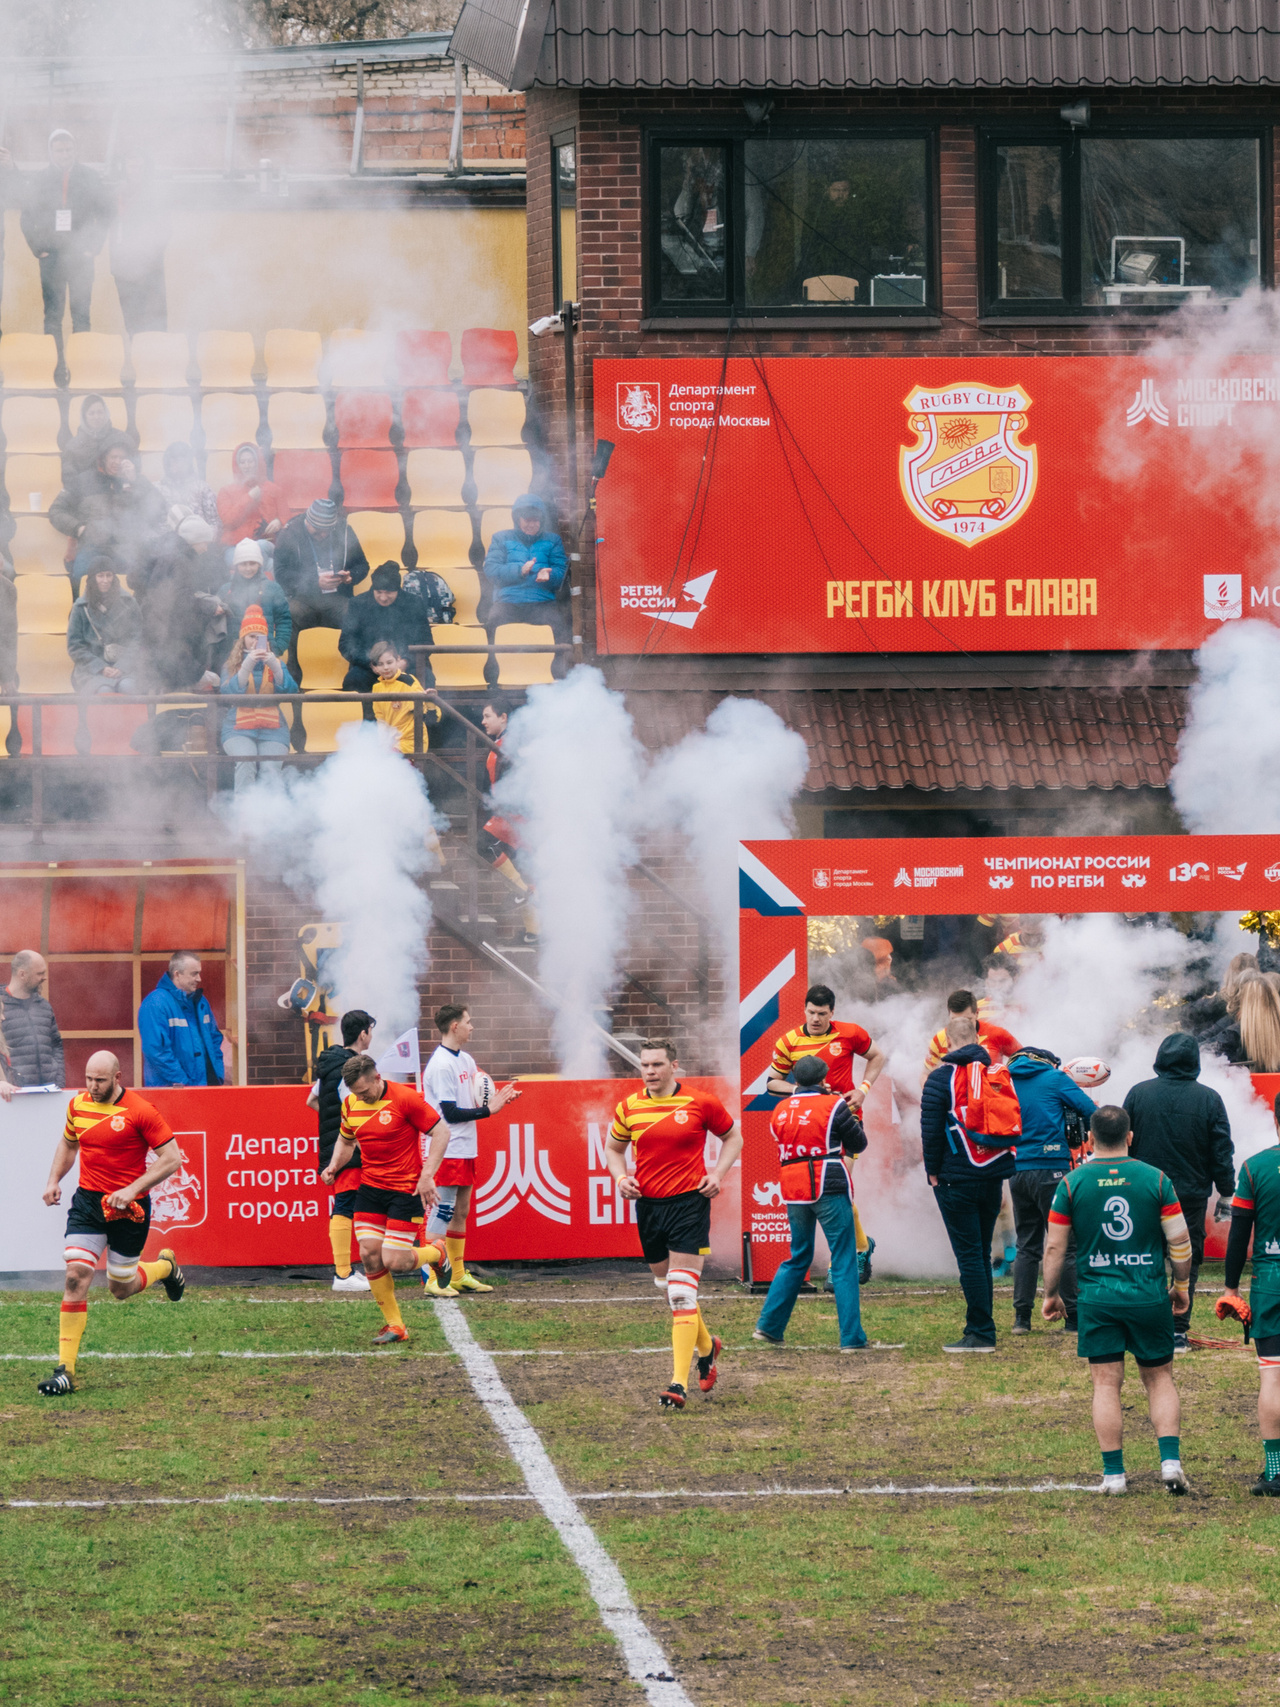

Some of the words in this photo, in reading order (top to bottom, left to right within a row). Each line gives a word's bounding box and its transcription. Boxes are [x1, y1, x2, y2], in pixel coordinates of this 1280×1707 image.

[669, 384, 757, 398] Департамент
[669, 402, 715, 414] спорта
[920, 393, 971, 410] RUGBY
[976, 393, 1017, 409] CLUB
[1177, 403, 1236, 427] СПОРТ
[669, 417, 715, 429] города
[718, 415, 770, 427] Москвы
[953, 521, 986, 534] 1974
[620, 585, 662, 596] РЕГБИ
[620, 597, 676, 609] РОССИИ
[826, 580, 913, 618] РЕГБИ
[923, 579, 996, 617] КЛУБ
[1005, 578, 1098, 616] СЛАВА
[984, 857, 1082, 870] ЧЕМПИОНАТ
[1084, 856, 1151, 869] РОССИИ
[913, 865, 964, 878] МОСКОВСКИЙ
[913, 877, 938, 888] СПОРТ
[1031, 875, 1055, 888] ПО
[1057, 875, 1105, 888] РЕГБИ
[227, 1168, 318, 1192] спорта
[228, 1200, 319, 1225] города
[1101, 1195, 1134, 1241] 3
[751, 1222, 791, 1232] РОССИ
[752, 1234, 768, 1243] ПО
[769, 1234, 793, 1243] РЕГБ
